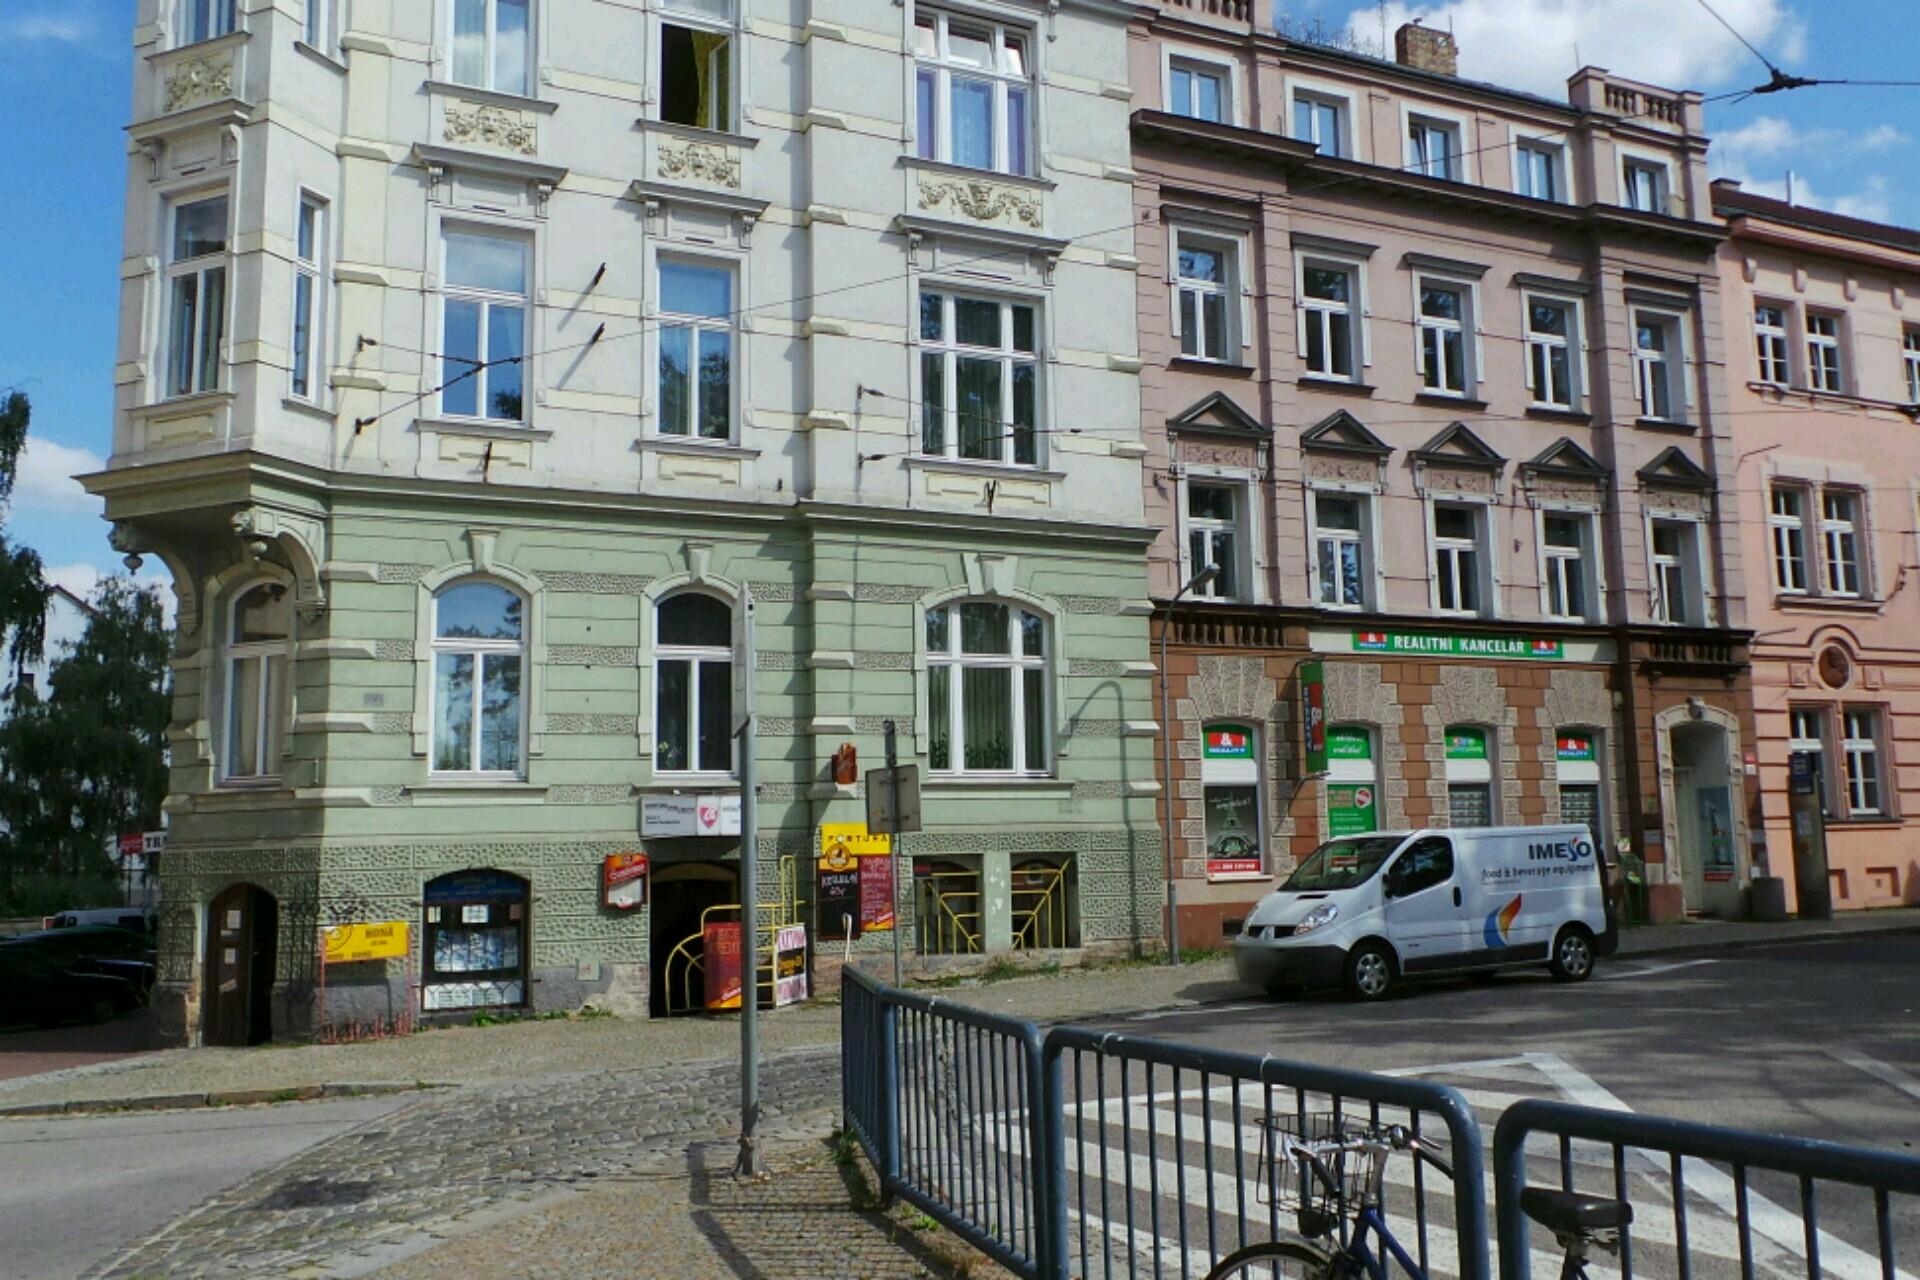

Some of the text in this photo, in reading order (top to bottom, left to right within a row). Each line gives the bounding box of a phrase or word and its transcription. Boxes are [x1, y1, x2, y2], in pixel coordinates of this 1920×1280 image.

[1393, 635, 1453, 650] REALITNÍ
[1481, 867, 1502, 880] food
[1512, 866, 1551, 878] beverage
[1552, 863, 1596, 876] equipment
